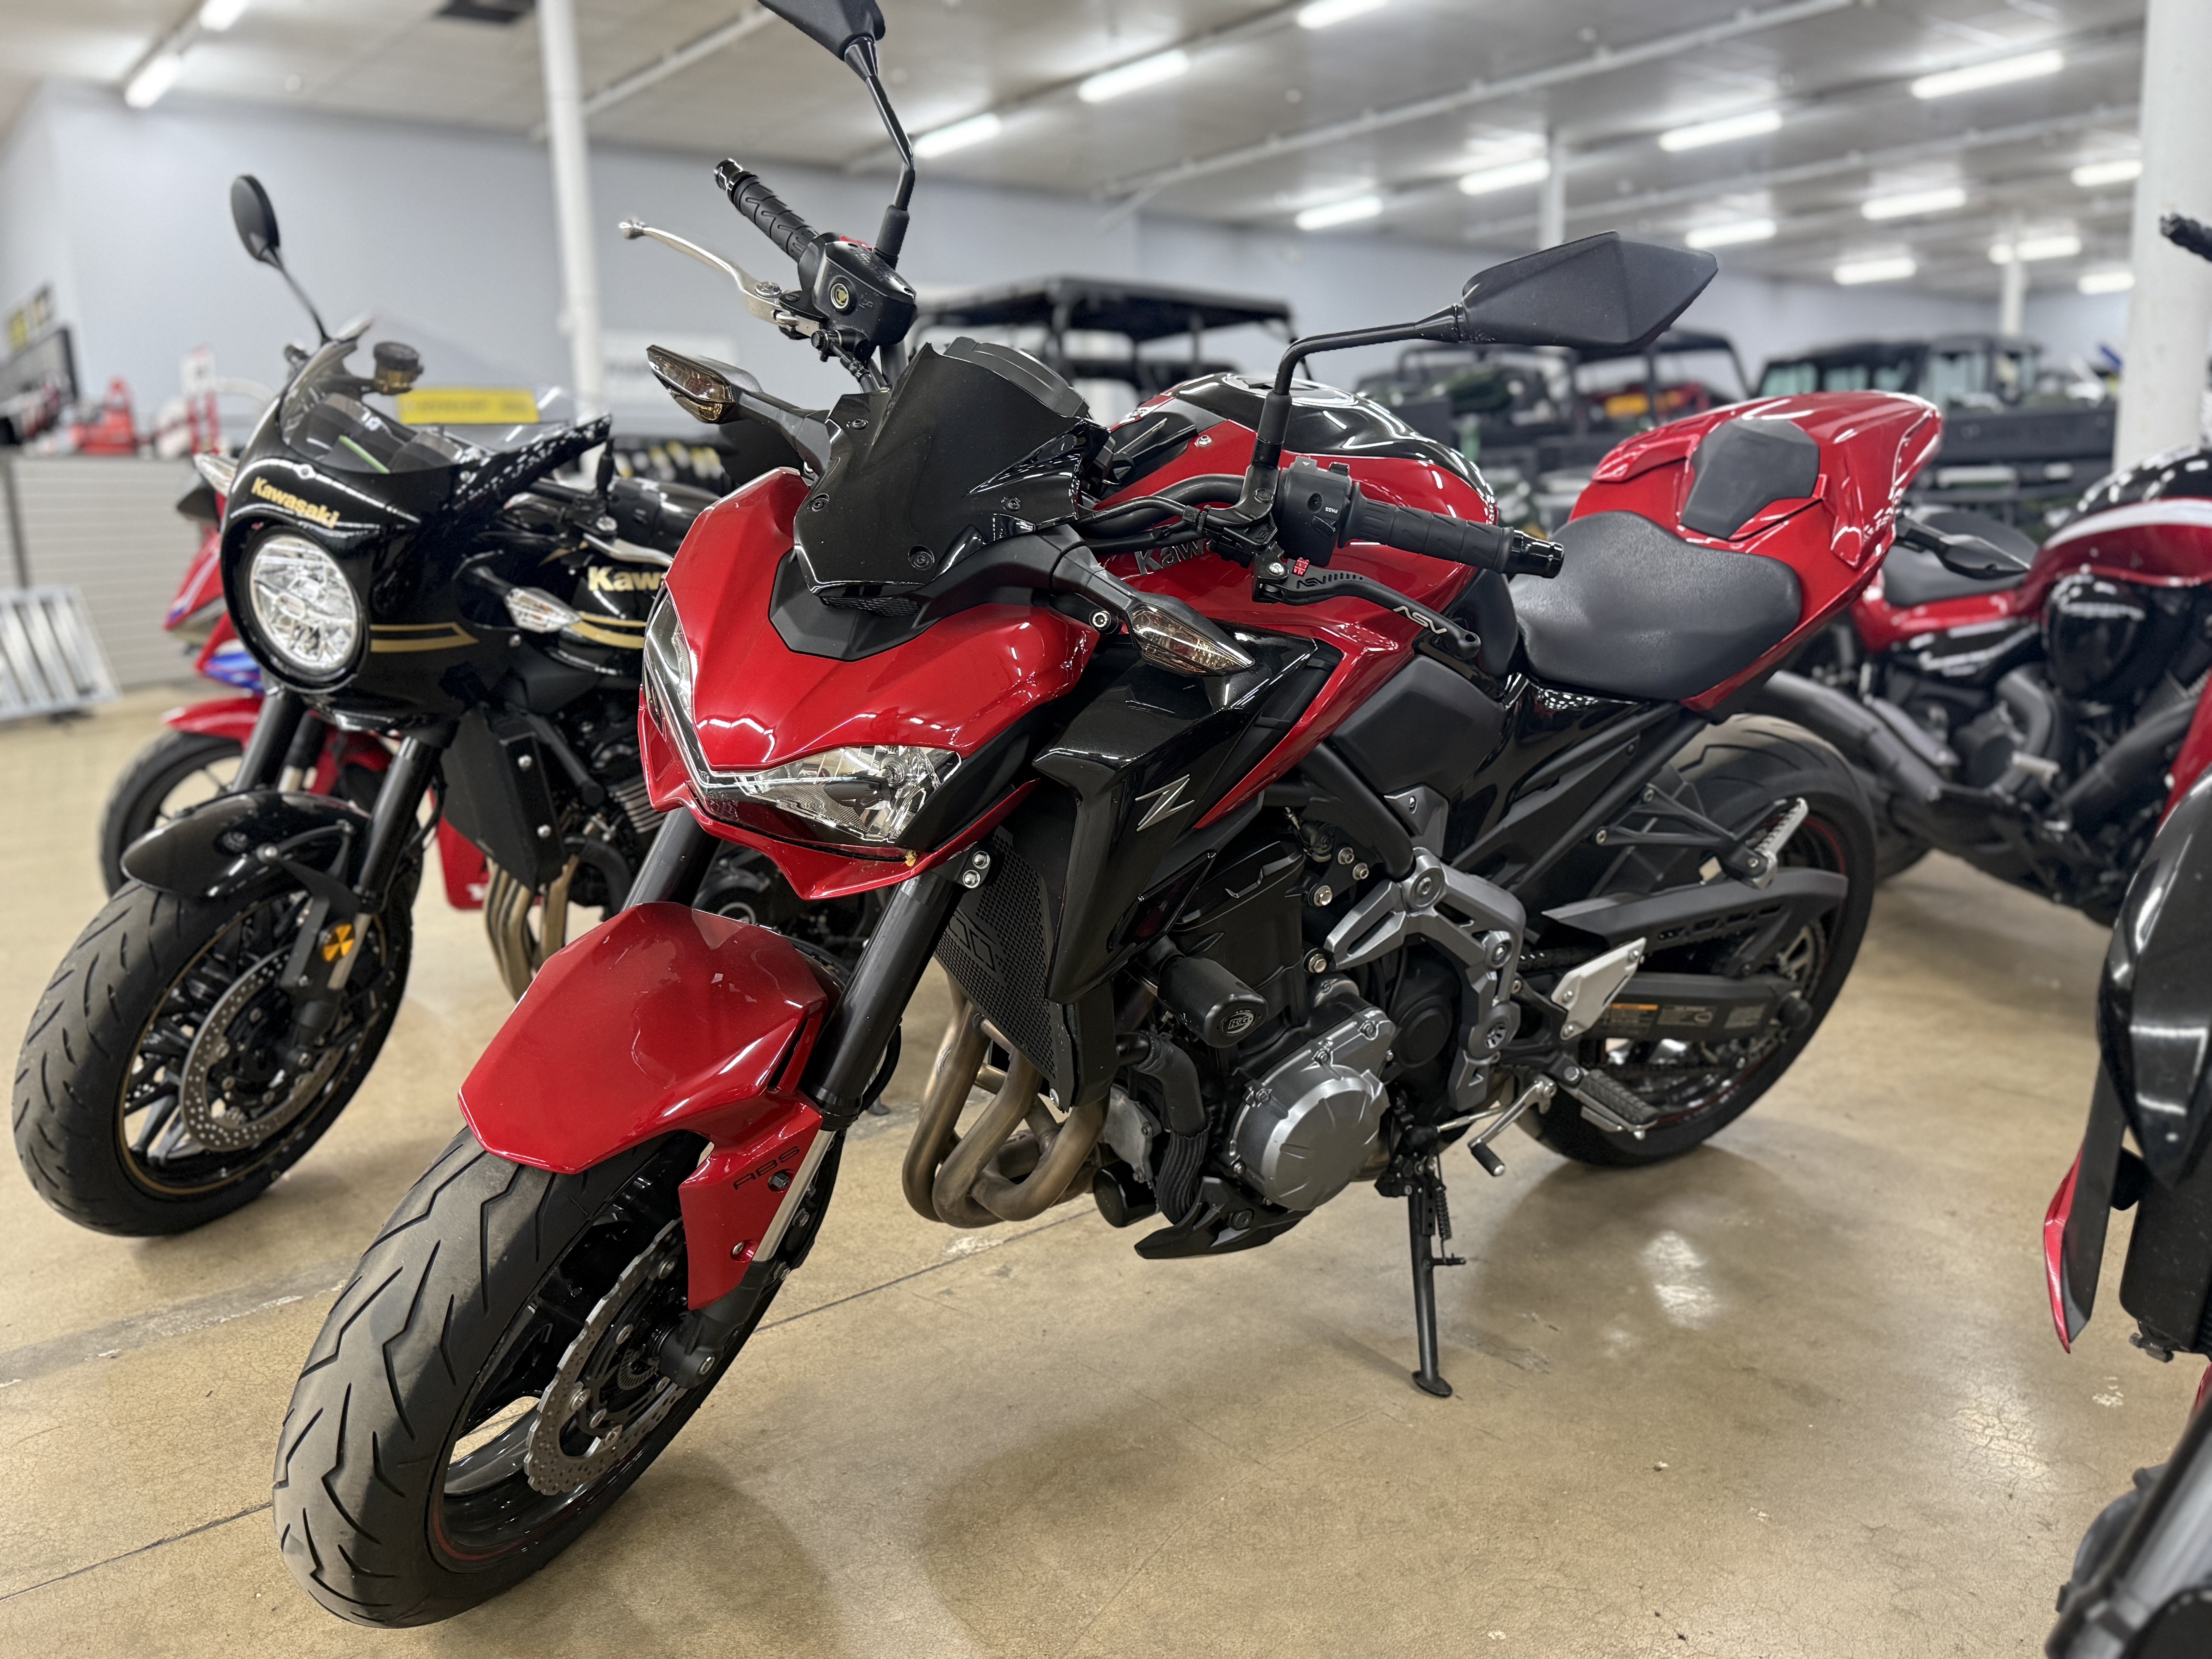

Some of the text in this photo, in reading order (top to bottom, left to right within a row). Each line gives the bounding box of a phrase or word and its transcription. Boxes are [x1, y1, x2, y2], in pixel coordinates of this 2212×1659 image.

[251, 476, 340, 529] Kawasaki
[1134, 539, 1212, 575] Kaw
[588, 566, 667, 591] Kaw
[1135, 774, 1195, 831] Z
[1228, 1016, 1250, 1029] R&G
[733, 1146, 800, 1190] ABS
